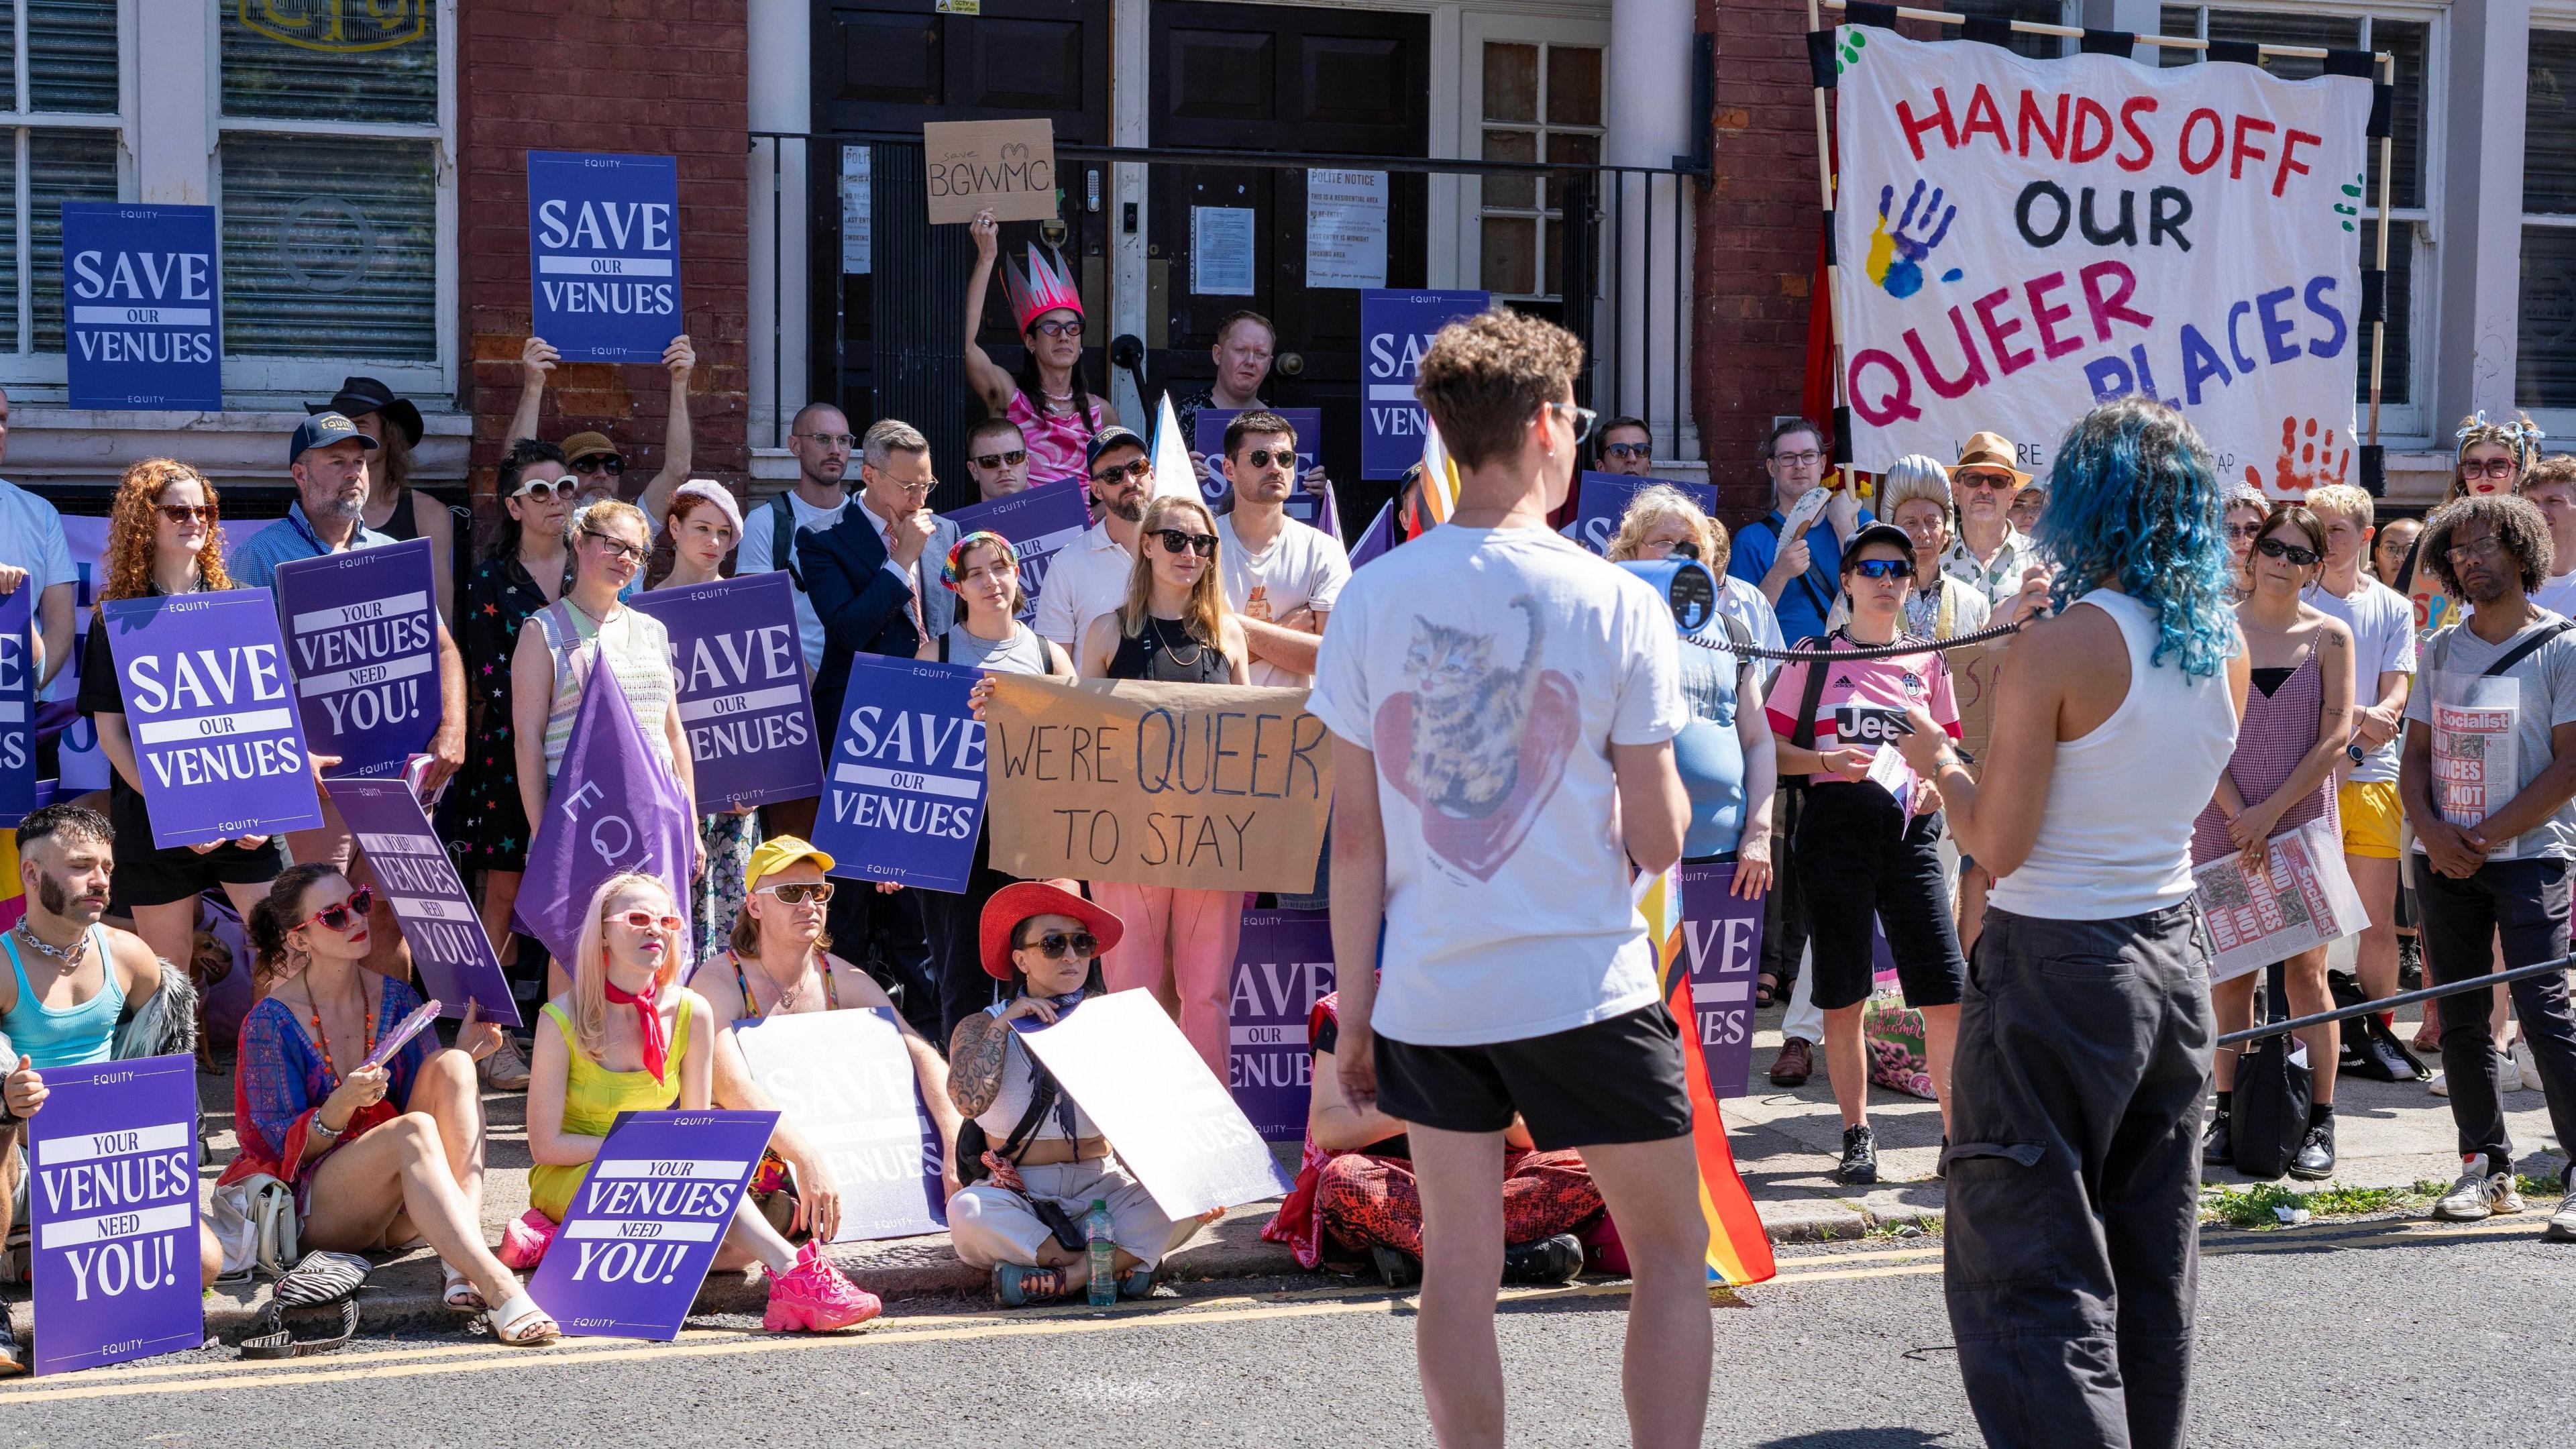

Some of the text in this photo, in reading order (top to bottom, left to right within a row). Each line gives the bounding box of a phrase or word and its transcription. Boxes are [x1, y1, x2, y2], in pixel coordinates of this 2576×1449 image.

[1896, 83, 2322, 197] HANDS OFF
[585, 159, 621, 168] EQUITY
[930, 160, 1050, 197] BGWMC
[1312, 171, 1375, 186] POLITE NOTICE
[121, 211, 158, 219] EQUITY
[539, 199, 672, 251] SAVE
[2016, 180, 2193, 252] OUR
[73, 250, 210, 301] SAVE
[591, 259, 622, 273] OUR
[541, 281, 674, 315] VENUES
[1411, 296, 1442, 304] EQUITY
[127, 309, 159, 323] OUR
[75, 331, 213, 364] VENUES
[592, 347, 627, 355] EQUITY
[1848, 260, 2155, 427] QUEER
[2083, 275, 2347, 413] PLACES
[1369, 333, 1436, 378] SA
[1370, 408, 1427, 435] VEN
[2017, 443, 2044, 466] RE
[993, 498, 1027, 515] EQUITY
[339, 555, 376, 569] EQUITY
[691, 587, 731, 601] EQUITY
[169, 600, 211, 614] EQUITY
[341, 602, 383, 623] YOUR
[296, 614, 430, 670] VENUES
[128, 643, 286, 714] SAVE
[349, 665, 386, 686] NEED
[913, 667, 952, 680] EQUITY
[321, 678, 419, 735] YOU!
[713, 696, 747, 714] OUR
[199, 717, 235, 736] OUR
[1837, 708, 1900, 740] Jee
[2443, 710, 2508, 729] Socialist
[685, 711, 808, 762] ENUES
[843, 706, 986, 772] SAVE
[146, 737, 301, 789] VENUES
[999, 707, 1328, 800] WE'RE QUEER
[360, 760, 394, 775] EQUITY
[891, 772, 924, 790] OUR
[360, 787, 382, 797] EQUITY
[727, 789, 765, 803] EQUITY
[2450, 786, 2483, 805] NOT
[218, 818, 260, 833] EQUITY
[832, 790, 973, 841] VENUES
[384, 835, 414, 851] YOUR
[1054, 809, 1256, 871] TO STAY
[370, 856, 459, 895] VENUES
[867, 864, 908, 877] EQUITY
[2292, 857, 2339, 936] the Socialist
[419, 900, 445, 917] NEED
[1244, 917, 1282, 926] EQUITY
[2209, 910, 2239, 949] WAR
[2235, 908, 2261, 939] NOT
[412, 921, 484, 967] YOU!
[1683, 918, 1755, 975] VE
[1229, 963, 1334, 1016] AVE
[1248, 1027, 1282, 1042] OUR
[93, 1071, 133, 1085] EQUITY
[674, 1118, 715, 1126] EQUITY
[1255, 1124, 1286, 1134] QUITY
[93, 1132, 139, 1155] YOUR
[649, 1162, 694, 1176] YOUR
[40, 1152, 191, 1214] VENUES
[587, 1181, 737, 1217] VENUES
[97, 1214, 140, 1238] NEED
[616, 1223, 663, 1237] NEED
[874, 1217, 914, 1229] EQUITY
[64, 1234, 174, 1301] YOU!
[572, 1242, 689, 1285] YOU!
[573, 1318, 616, 1328] EQUITY
[102, 1338, 143, 1356] EQUITY
